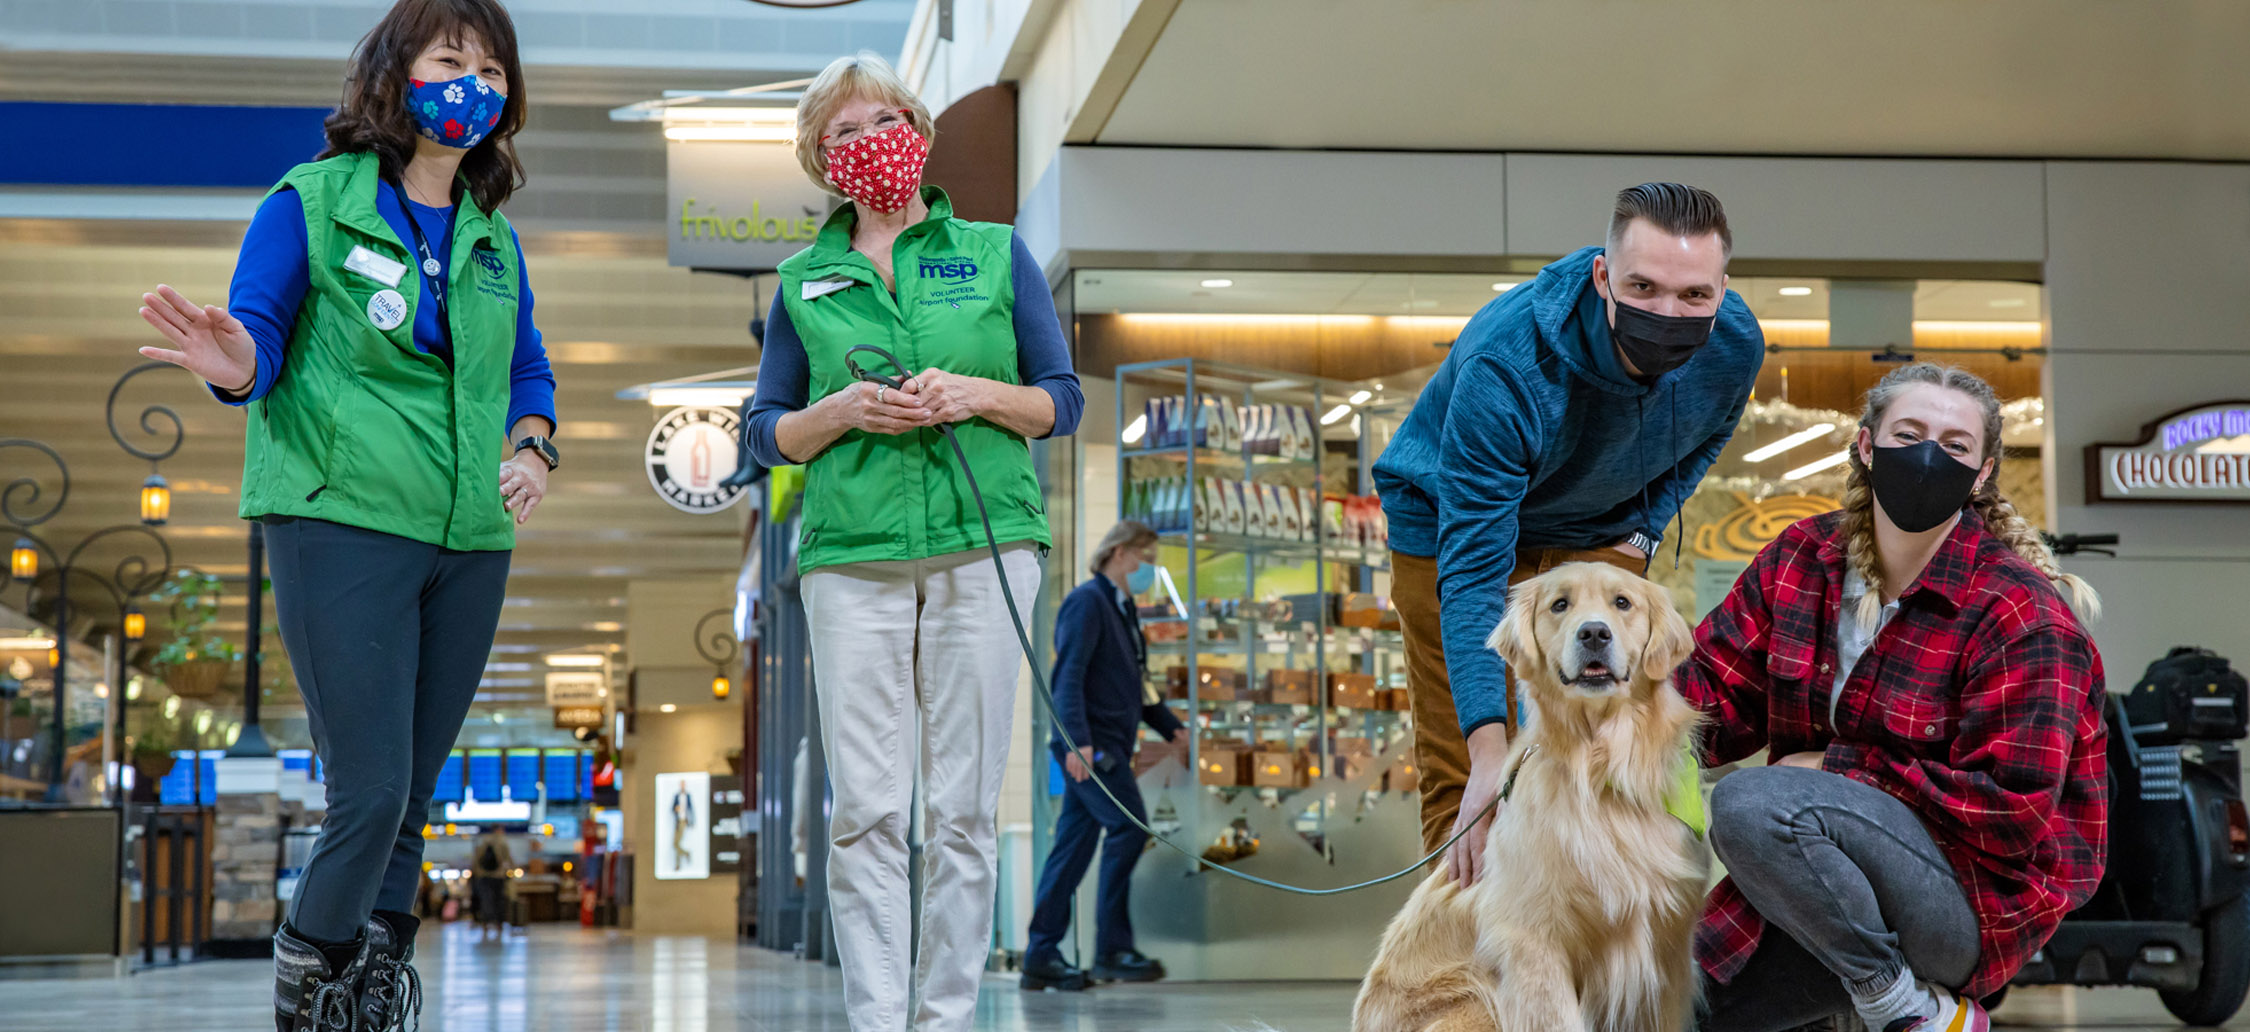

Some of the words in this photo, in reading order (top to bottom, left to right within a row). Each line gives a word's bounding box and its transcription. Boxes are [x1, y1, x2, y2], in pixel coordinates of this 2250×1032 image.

[681, 198, 817, 241] frivolous
[919, 263, 978, 280] msp
[930, 287, 976, 297] VOLUNTEER
[945, 294, 989, 304] foundation
[375, 294, 400, 322] TRAVEL
[652, 409, 700, 453] LAKE
[2163, 411, 2223, 451] ROCKY
